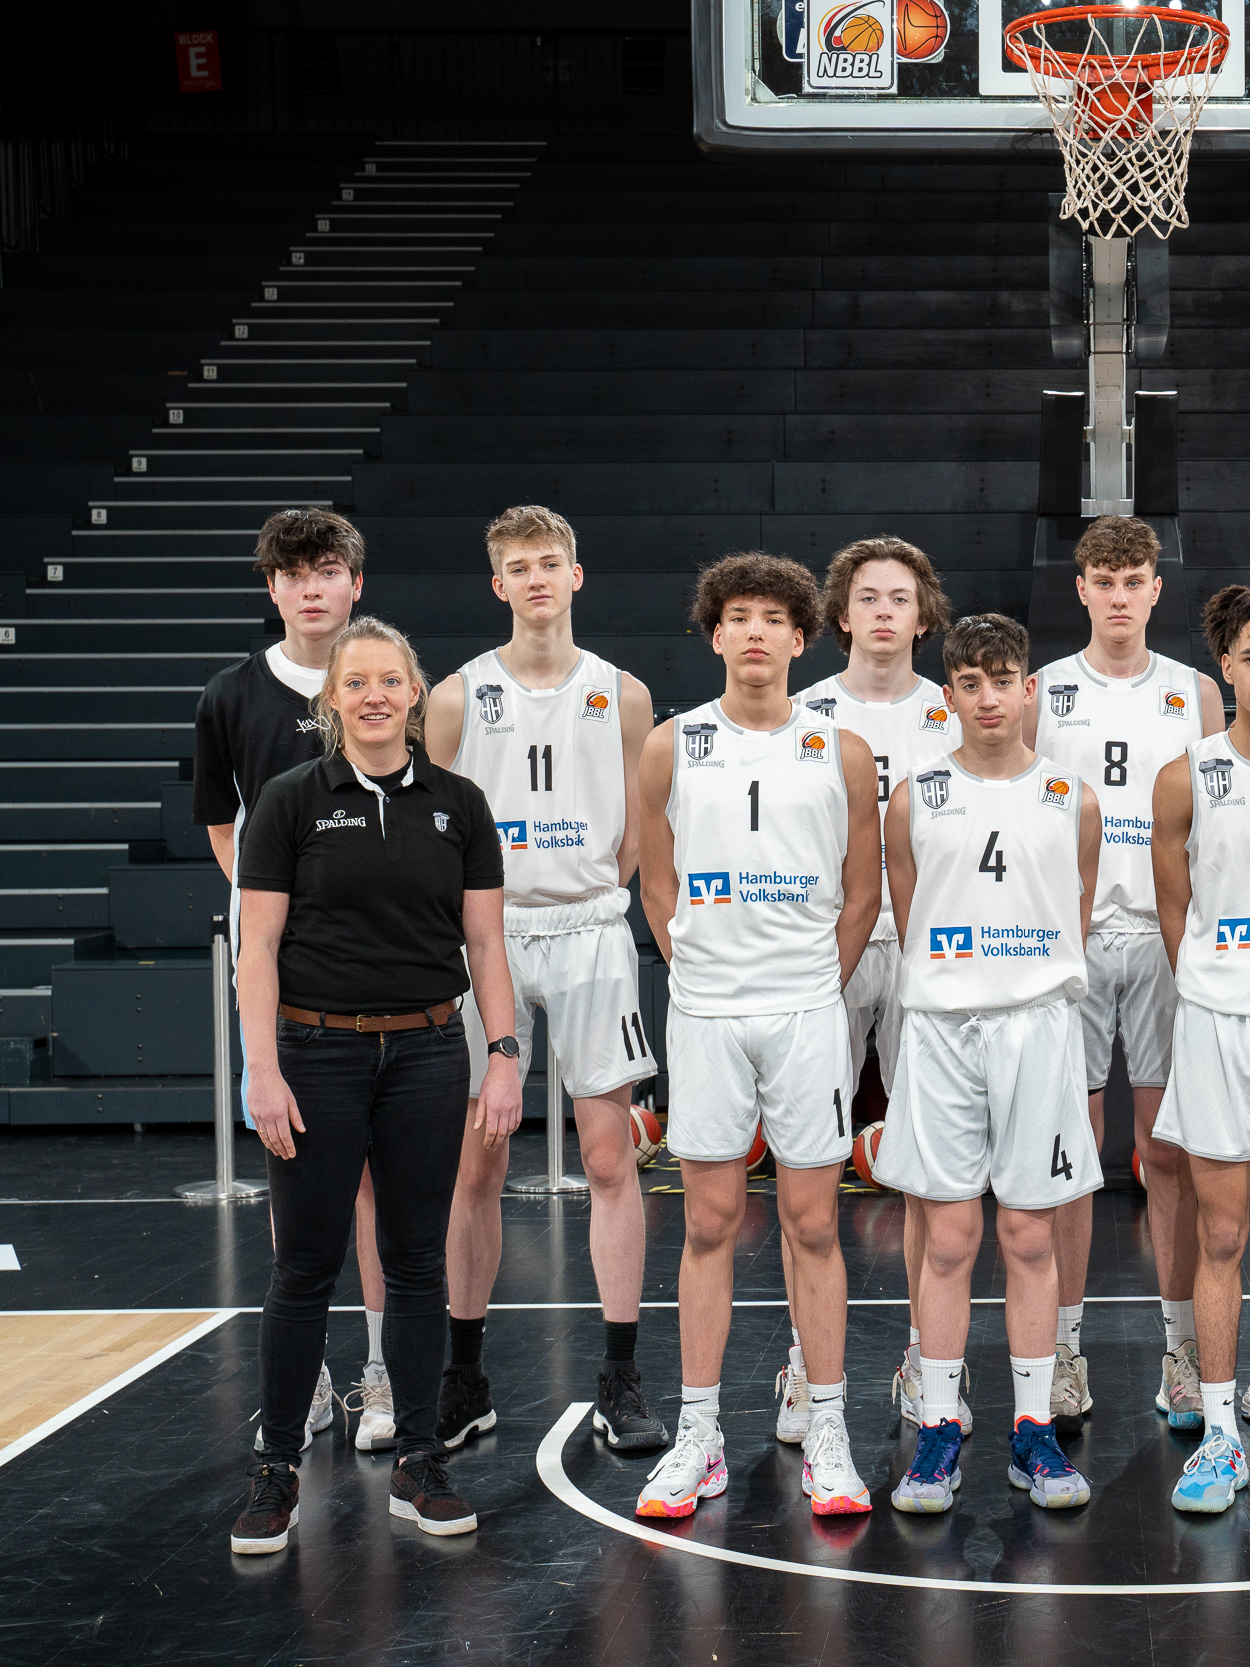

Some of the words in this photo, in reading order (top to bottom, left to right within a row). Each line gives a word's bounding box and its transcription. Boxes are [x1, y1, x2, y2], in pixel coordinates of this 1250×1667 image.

[178, 32, 214, 45] BLOCK
[188, 45, 209, 78] E
[817, 52, 882, 78] NBBL
[172, 411, 182, 419] 10
[136, 459, 142, 467] 9
[96, 511, 102, 519] 8
[53, 567, 58, 575] 7
[4, 629, 10, 638] 6
[481, 697, 501, 721] HH
[582, 706, 605, 719] JBBL
[1053, 694, 1074, 716] HH
[1162, 705, 1185, 716] JBBL
[922, 719, 945, 731] JBBL
[1058, 719, 1091, 729] SPALDING
[688, 735, 710, 759] HH
[800, 748, 824, 759] JBBL
[527, 744, 553, 792] 11
[687, 760, 725, 769] SPALDING
[1104, 740, 1129, 787] 8
[1206, 770, 1230, 799] HH
[924, 781, 947, 808] HH
[1042, 791, 1066, 806] JBBL
[1209, 796, 1246, 809] SPALDING
[748, 780, 759, 832] 1
[931, 806, 966, 820] SPALDING
[315, 816, 367, 832] SPALDING
[978, 831, 1007, 883] 4
[739, 870, 820, 889] Hamburger
[980, 925, 1061, 942] Hamburger
[980, 943, 1050, 957] Volksbank
[621, 1011, 648, 1062] 11
[833, 1087, 845, 1138] 1
[1051, 1133, 1074, 1181] 4
